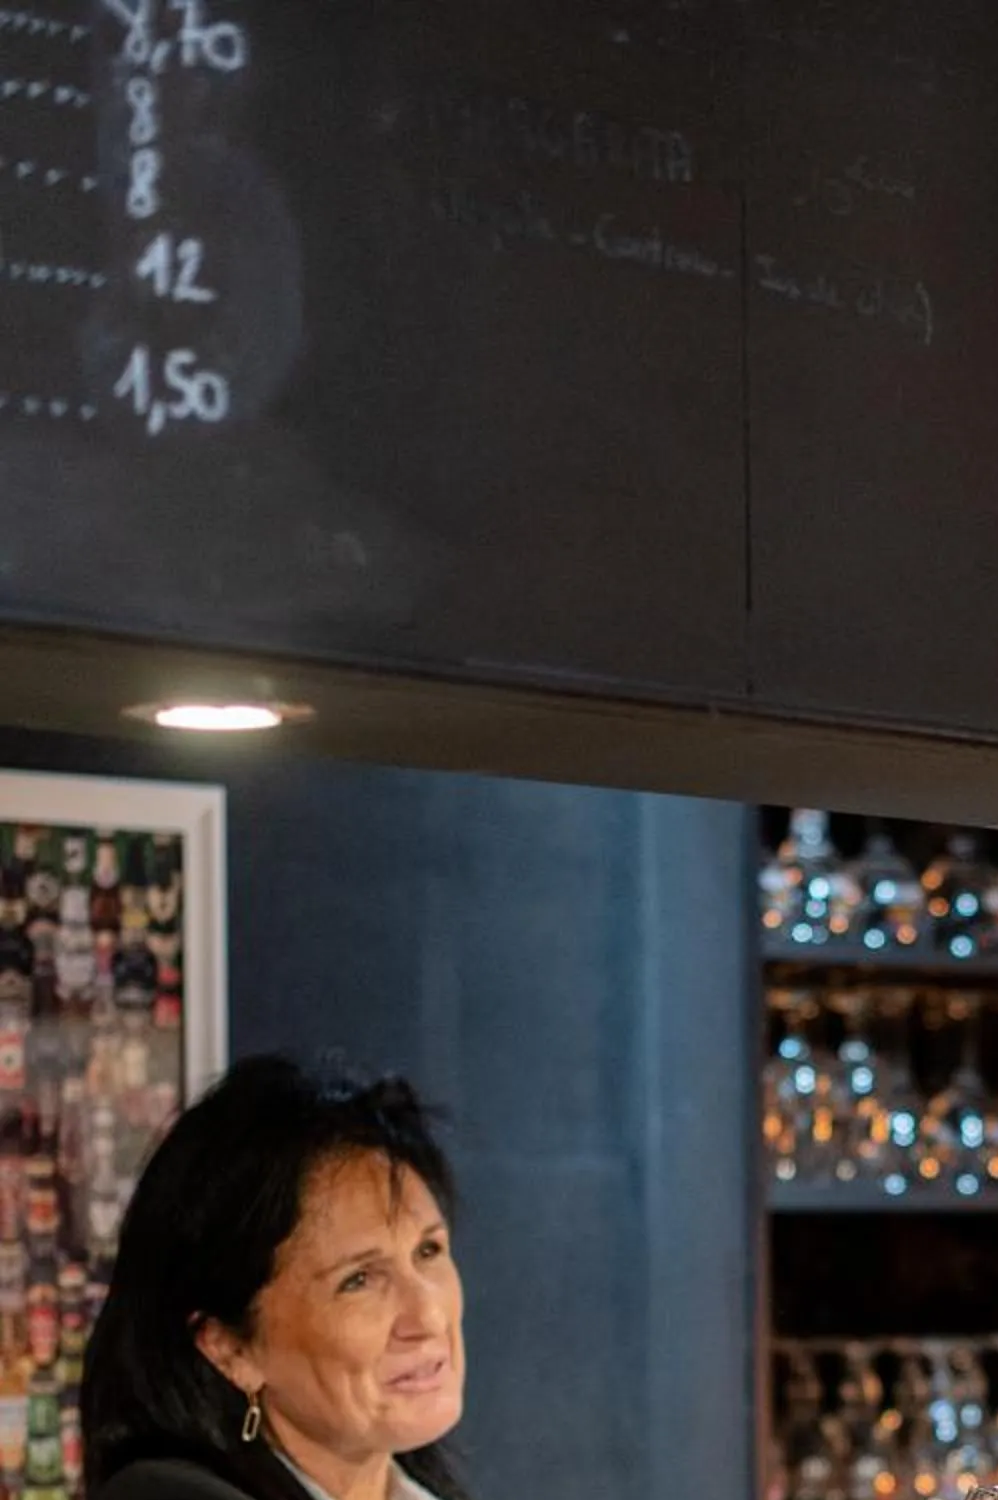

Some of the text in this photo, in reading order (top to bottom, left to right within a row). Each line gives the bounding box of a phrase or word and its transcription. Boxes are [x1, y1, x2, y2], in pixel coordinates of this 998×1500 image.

[126, 76, 157, 145] 8
[125, 148, 162, 219] 8
[136, 233, 217, 302] 12
[113, 344, 229, 436] 1,50
